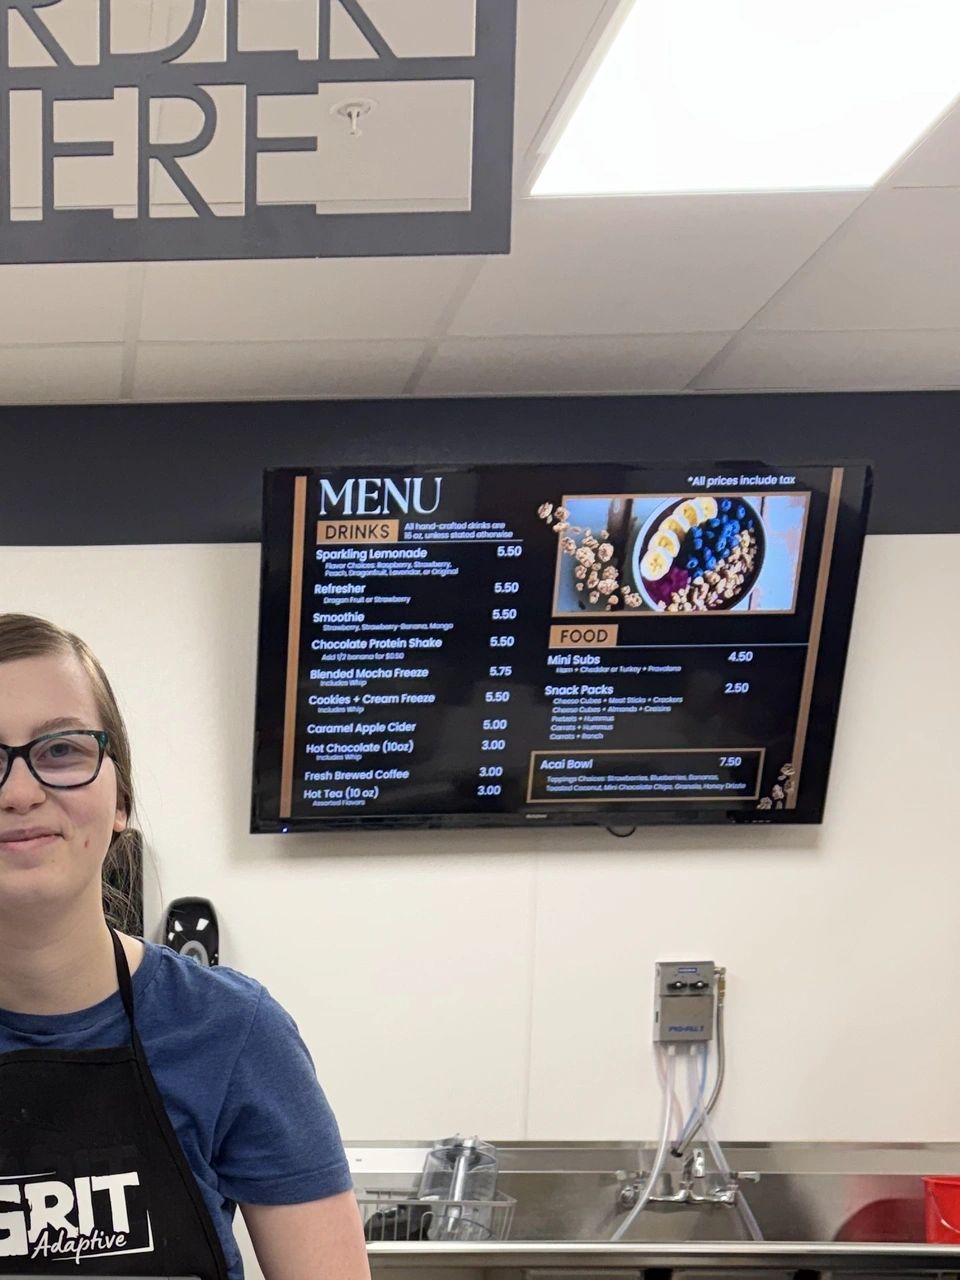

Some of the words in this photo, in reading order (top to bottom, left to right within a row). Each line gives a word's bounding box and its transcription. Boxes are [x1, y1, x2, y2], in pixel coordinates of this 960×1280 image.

[706, 475, 738, 488] prices
[740, 475, 777, 485] include
[779, 475, 795, 485] tax
[319, 476, 442, 516] MENU
[325, 523, 390, 540] DRINKS
[404, 522, 414, 530] All
[416, 521, 467, 530] hand-crafted
[468, 521, 489, 530] drinks
[424, 531, 448, 540] unless
[450, 531, 474, 539] stated
[476, 530, 513, 539] otherwise
[316, 548, 367, 562] Sparkling
[369, 547, 428, 560] Lemonade
[497, 545, 522, 557] 5.50
[314, 583, 366, 595] Refresher
[494, 582, 519, 593] 5.50
[313, 611, 365, 623] Smoothie
[492, 609, 517, 620] 5.50
[311, 638, 367, 650] Chocolate
[369, 637, 407, 649] Protein
[409, 637, 442, 648] Shake
[490, 636, 515, 647] 5.50
[560, 629, 608, 643] FOOD
[547, 654, 571, 665] Mini
[573, 654, 601, 665] Subs
[728, 651, 753, 662] 4.50
[310, 669, 354, 680] Blended
[355, 668, 392, 679] Mocha
[394, 667, 429, 678] Freeze
[490, 666, 512, 677] 5.75
[544, 685, 579, 695] Snack
[580, 684, 614, 695] Packs
[724, 683, 749, 694] 2.50
[308, 694, 350, 706] Cookies
[362, 694, 399, 704] Cream
[401, 693, 436, 704] Freeze
[485, 692, 510, 702] 5.50
[307, 723, 353, 734] Caramel
[355, 723, 386, 736] Apple
[387, 721, 416, 733] Cider
[483, 719, 507, 730] 5.00
[306, 743, 324, 754] Hot
[326, 742, 380, 753] Chocolate
[382, 740, 414, 754] (10oz)
[481, 739, 506, 750] 3.00
[540, 758, 565, 769] Acai
[567, 758, 593, 769] Bowl
[720, 757, 741, 767] 7.50
[304, 770, 333, 781] Fresh
[335, 769, 373, 780] Brewed
[375, 769, 410, 780] Coffee
[479, 766, 503, 777] 3.00
[304, 789, 322, 799] Hot
[323, 789, 343, 799] Tea
[345, 786, 360, 799] (10
[362, 786, 379, 799] oz)
[477, 785, 501, 796] 3.00
[30, 1229, 127, 1264] Adaptive
